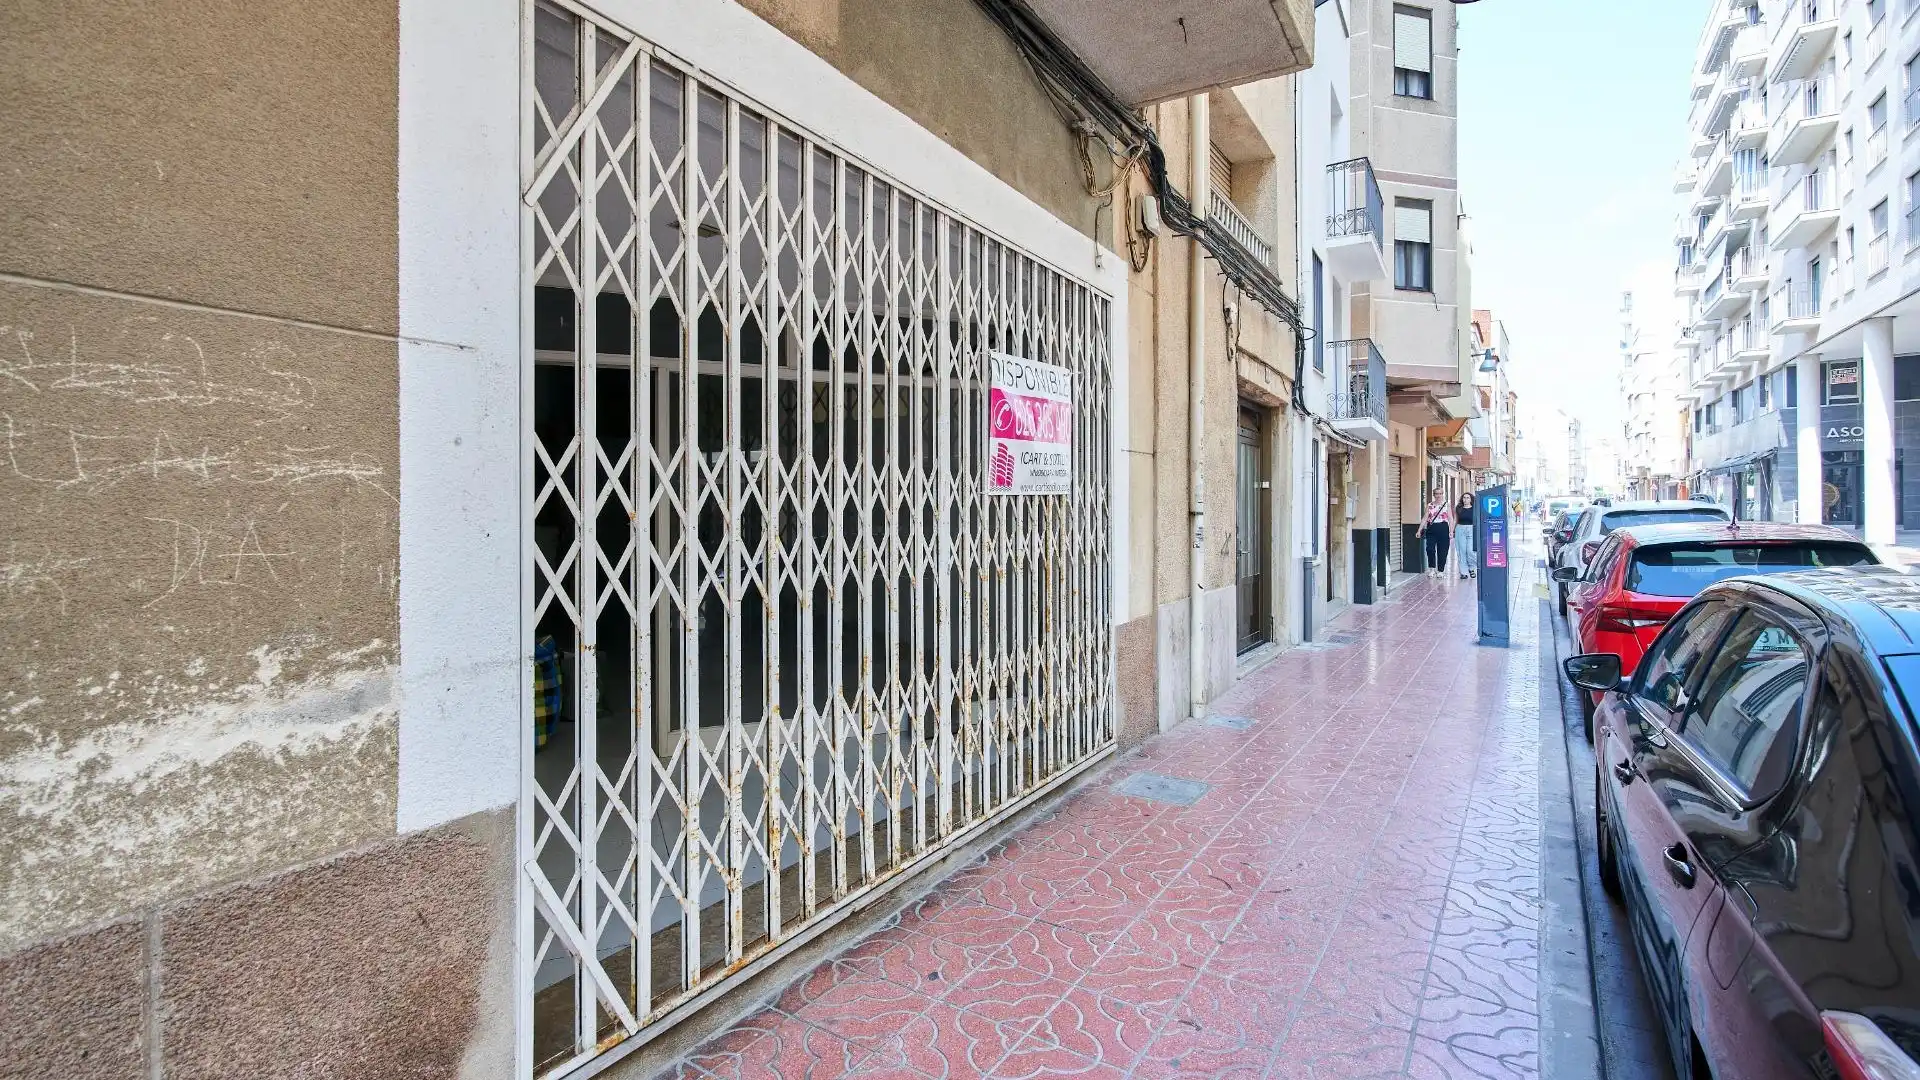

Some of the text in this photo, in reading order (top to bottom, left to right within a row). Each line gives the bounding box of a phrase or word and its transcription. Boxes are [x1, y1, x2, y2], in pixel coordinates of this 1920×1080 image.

[991, 357, 1070, 397] DISPONIBLE
[1020, 451, 1043, 465] ICART
[1043, 452, 1049, 466] &
[1488, 498, 1499, 513] P
